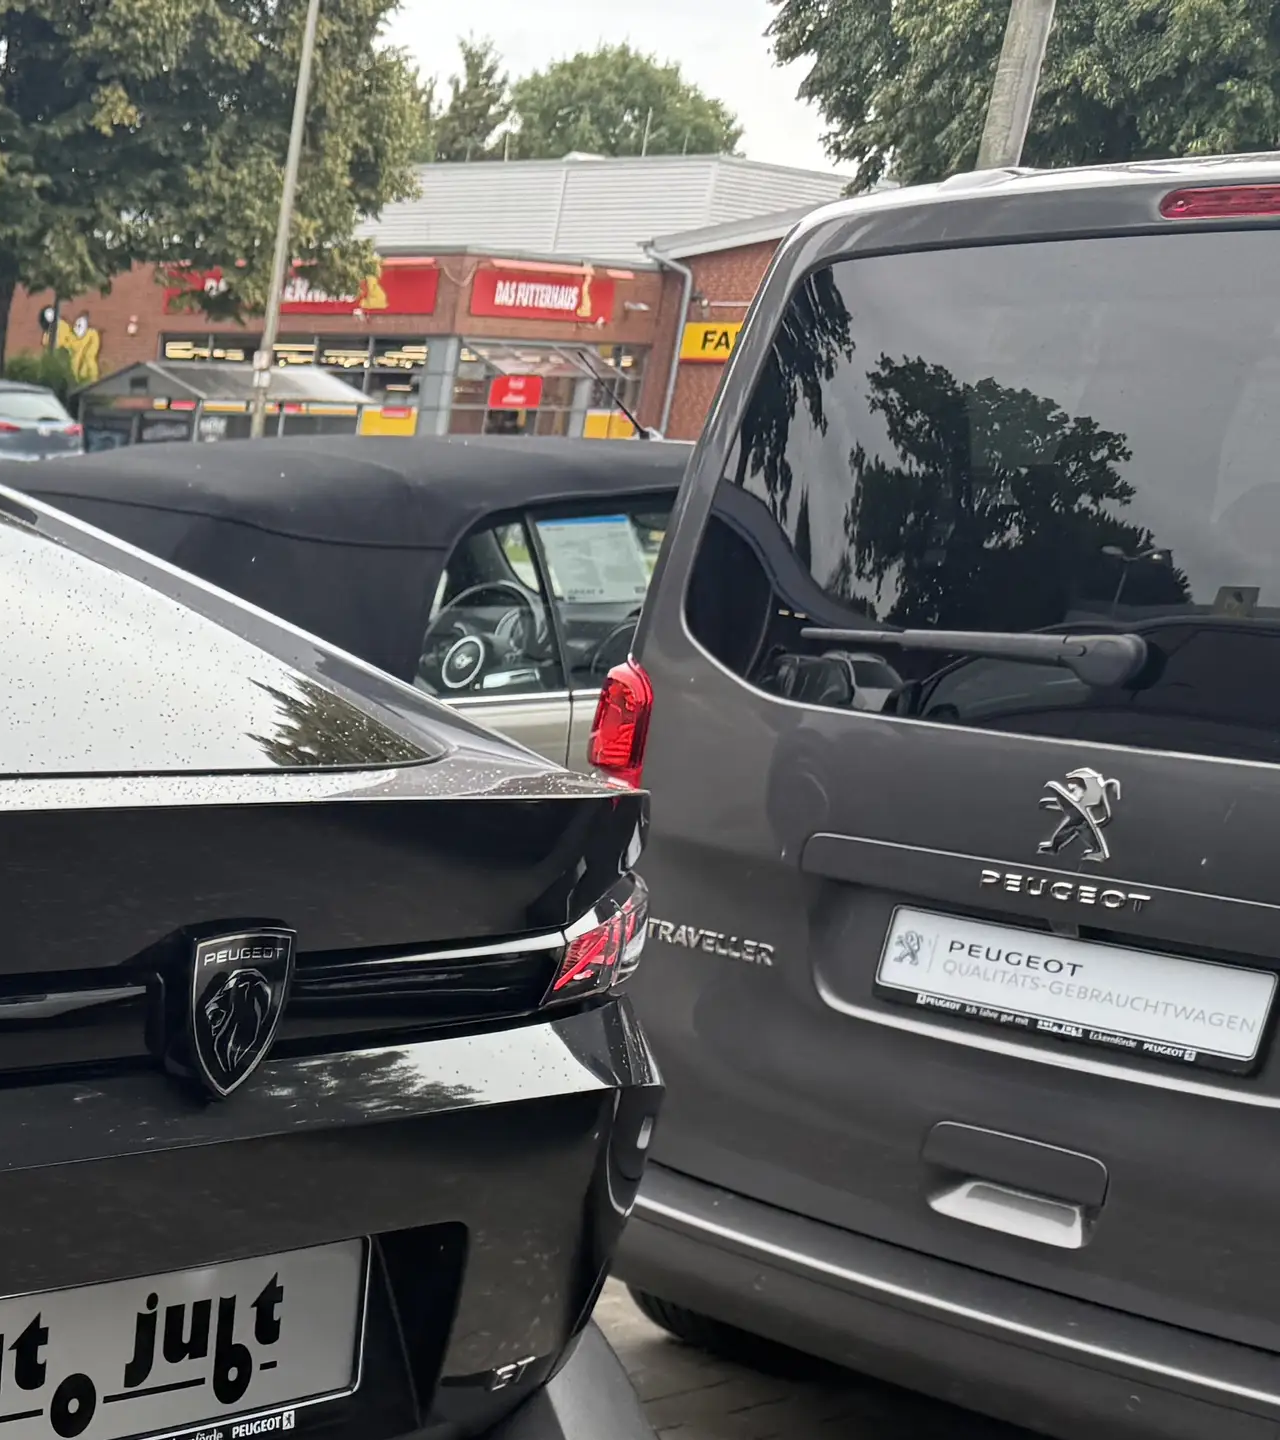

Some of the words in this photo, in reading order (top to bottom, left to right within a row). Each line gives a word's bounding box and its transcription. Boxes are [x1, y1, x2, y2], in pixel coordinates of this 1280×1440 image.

[494, 280, 517, 306] DAS
[515, 282, 580, 311] FUTTERHAUS
[701, 330, 739, 351] FA
[980, 869, 1152, 911] PEUGEOT
[648, 917, 775, 966] TRAVELLER
[203, 947, 284, 967] PEUGEOT
[948, 940, 1083, 977] PEUGEOT
[1143, 1042, 1185, 1057] PEUGEOT
[231, 1415, 282, 1439] PEUGEOT
